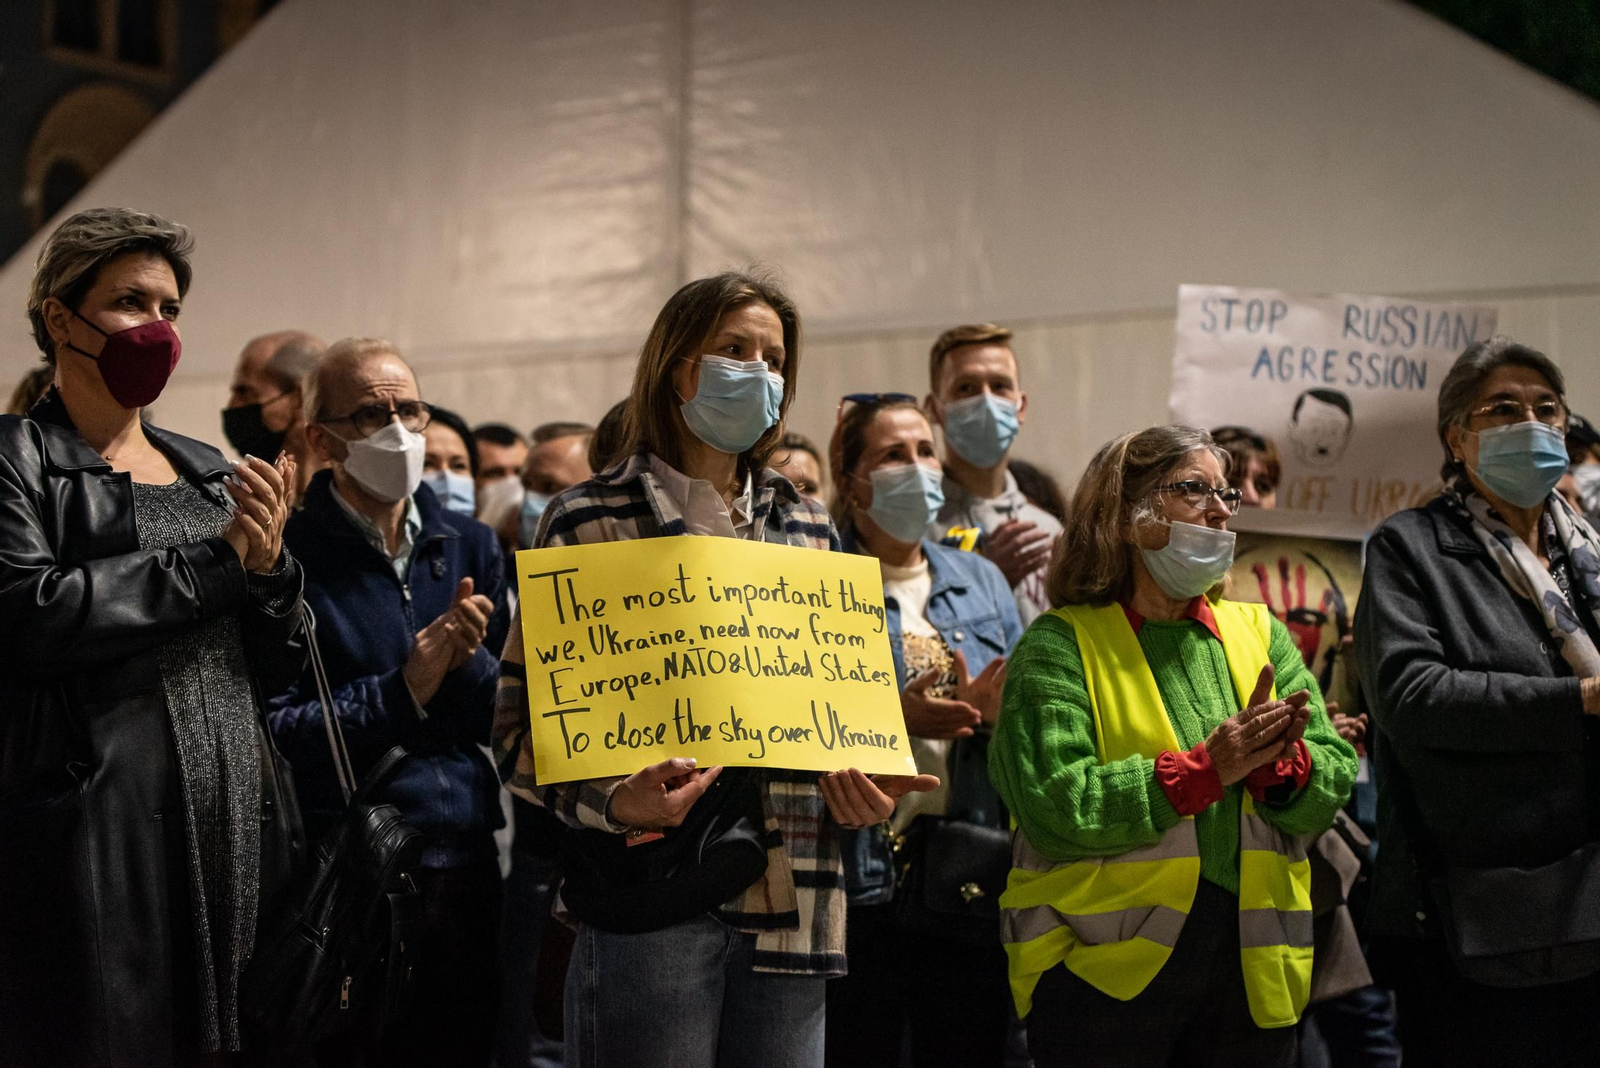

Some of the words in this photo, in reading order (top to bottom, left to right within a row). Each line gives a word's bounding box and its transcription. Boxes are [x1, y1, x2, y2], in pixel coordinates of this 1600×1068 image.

[1200, 298, 1289, 333] STOP
[1342, 304, 1479, 349] RUSSIAN
[1251, 345, 1428, 390] AGRESSION
[528, 567, 606, 625] The
[622, 563, 696, 611] most
[706, 576, 832, 617] important
[838, 579, 885, 633] thing
[699, 615, 750, 640] need
[756, 624, 800, 641] now
[809, 613, 866, 650] from
[820, 652, 891, 687] States
[542, 707, 591, 760] To
[604, 711, 667, 750] close
[672, 697, 712, 745] the
[718, 705, 766, 759] sky
[768, 725, 814, 743] over
[810, 700, 899, 751] Ukraine
